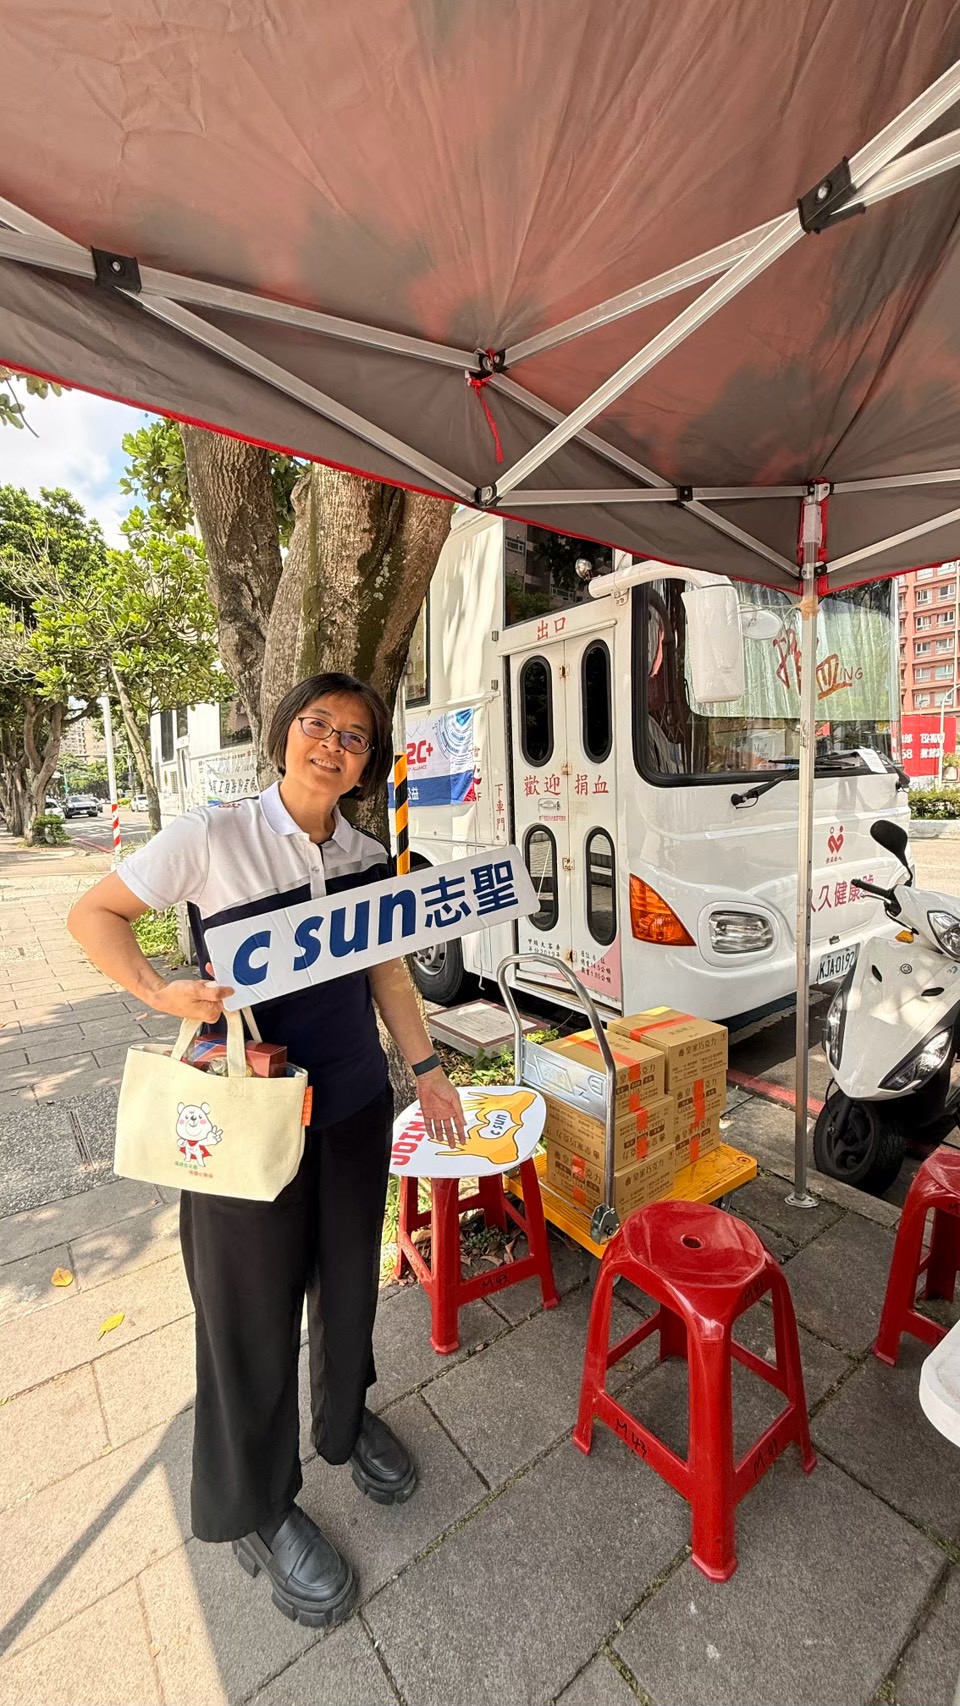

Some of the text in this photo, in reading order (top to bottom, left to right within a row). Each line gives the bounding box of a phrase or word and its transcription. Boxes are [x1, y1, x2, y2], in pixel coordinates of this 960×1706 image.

[537, 617, 566, 641] 出口
[406, 740, 434, 766] 2C+
[494, 783, 506, 832] 下車門
[232, 859, 519, 987] c sun 志聖
[391, 1121, 426, 1166] JOIN
